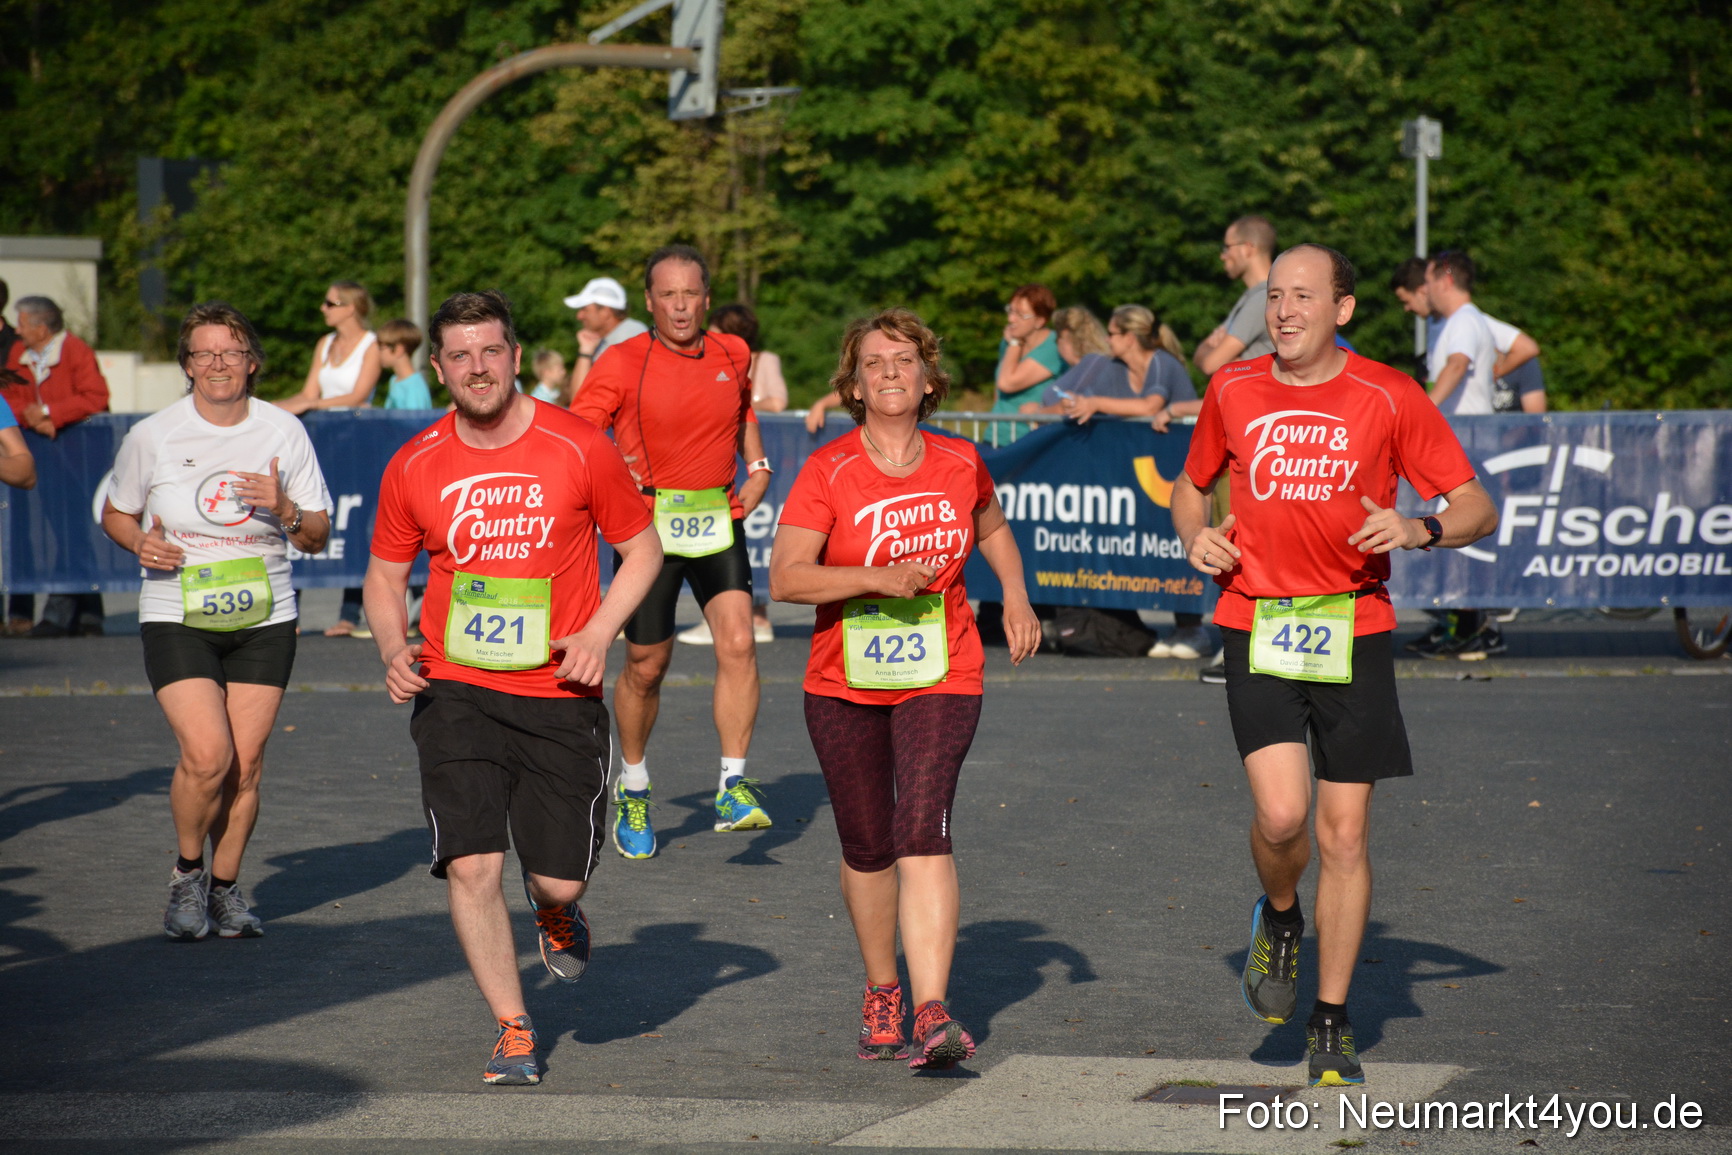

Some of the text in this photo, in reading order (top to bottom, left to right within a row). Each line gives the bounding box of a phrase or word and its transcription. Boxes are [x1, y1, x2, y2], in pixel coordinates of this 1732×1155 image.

[422, 430, 439, 442] JAKO
[1244, 410, 1349, 455] Town &
[1250, 445, 1359, 501] Country
[440, 472, 543, 520] Town &
[1280, 484, 1333, 501] HAUS
[670, 516, 716, 538] 982
[854, 492, 957, 542] Town &
[1498, 491, 1732, 547] Fische
[447, 508, 555, 564] Country
[480, 542, 531, 560] HAUS
[864, 527, 969, 567] Country
[1035, 526, 1093, 554] Druck
[1098, 530, 1135, 556] und
[1036, 568, 1204, 595] www.frischmann-net.de
[202, 589, 254, 616] 539
[464, 613, 524, 645] 421
[1272, 624, 1332, 655] 422
[864, 633, 926, 664] 423
